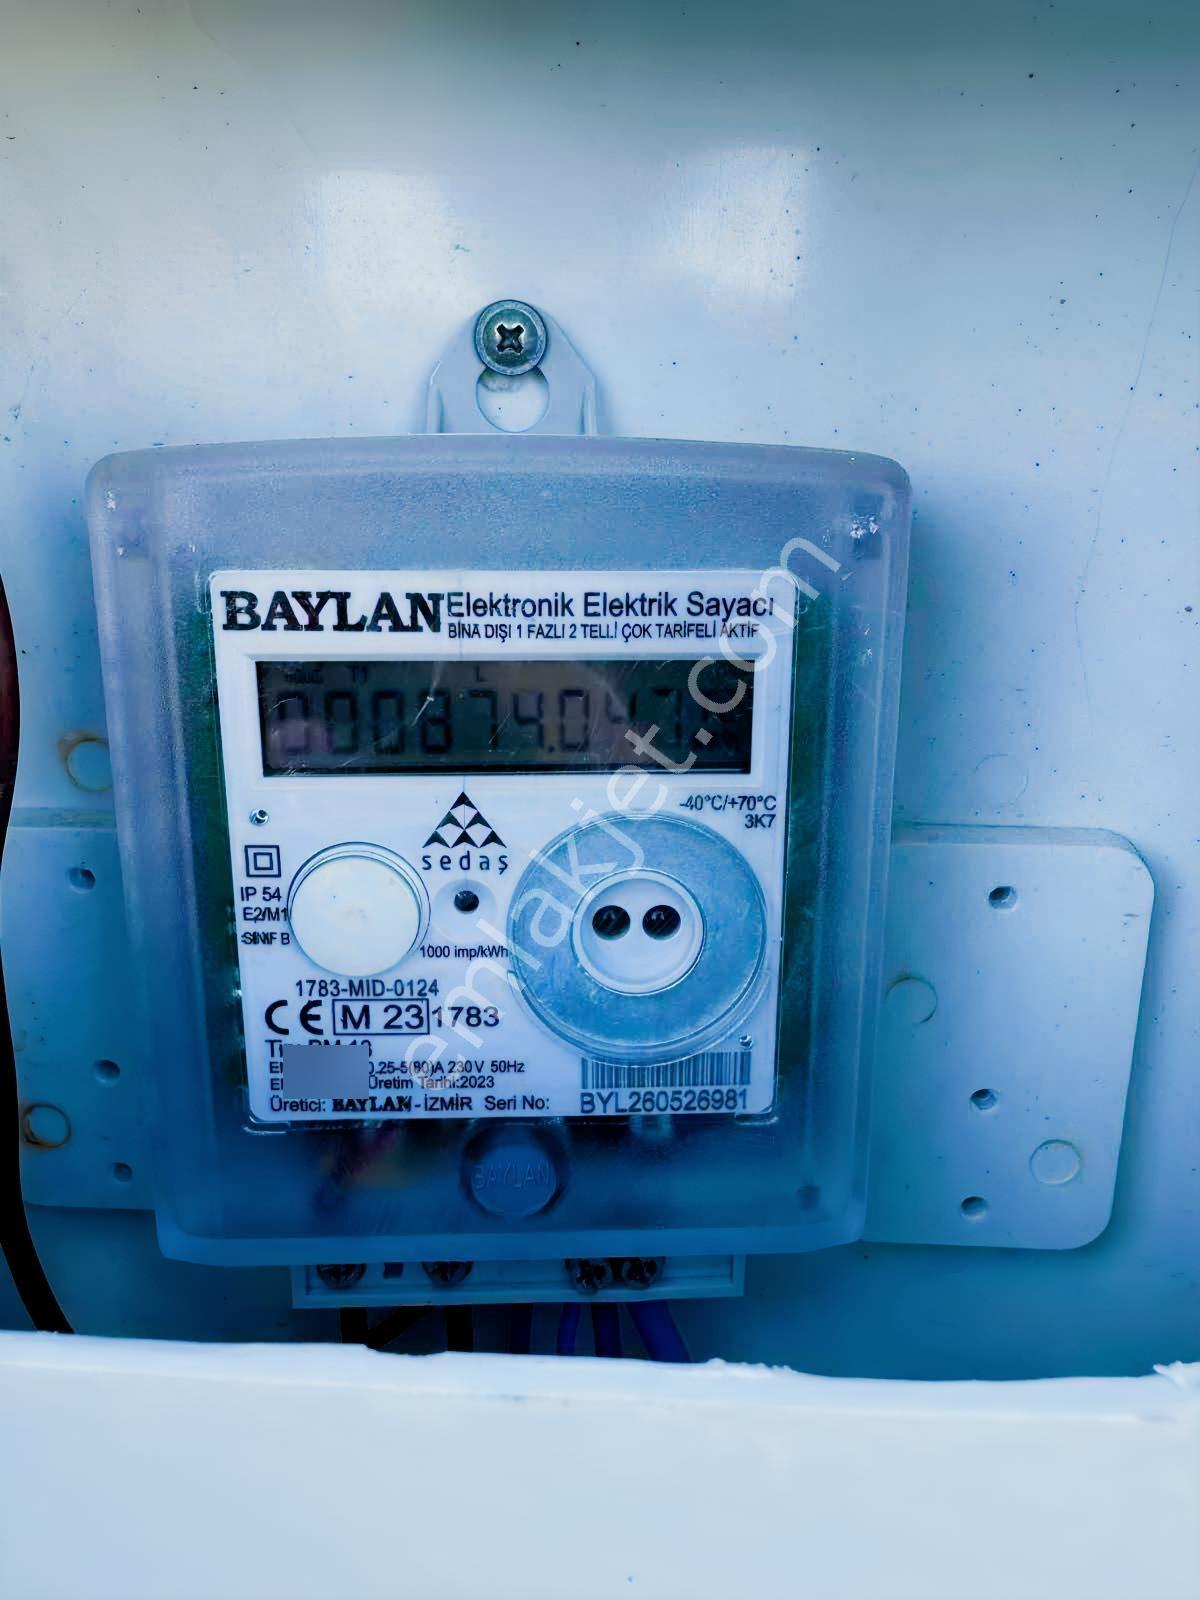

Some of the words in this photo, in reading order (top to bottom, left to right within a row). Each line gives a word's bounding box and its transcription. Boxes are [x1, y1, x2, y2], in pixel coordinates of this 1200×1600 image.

[220, 590, 444, 632] BAYLAN
[447, 591, 574, 618] Elektronik
[583, 591, 678, 618] Elektrik
[686, 590, 774, 622] Sayacı
[448, 620, 481, 639] BİNA
[484, 623, 511, 642] DIŞI
[517, 623, 522, 638] 1
[527, 623, 565, 639] FAZLI
[569, 623, 577, 638] 2
[622, 622, 652, 642] ÇOK
[656, 620, 716, 639] TARİFELİ
[720, 620, 760, 638] AKTİF
[745, 814, 776, 829] 3K7
[422, 850, 508, 875] sedaş
[241, 887, 257, 902] IP
[262, 887, 282, 902] 54
[243, 907, 288, 922] E2/M1
[281, 933, 290, 945] B
[420, 945, 450, 959] 1000
[454, 945, 509, 961] imp/kWh
[295, 979, 439, 998] 1783-MID-0124
[341, 1004, 370, 1030] M
[383, 1004, 425, 1030] 23
[432, 1006, 500, 1028] 1783
[448, 1060, 472, 1074] 230
[490, 1060, 525, 1074] 50Hz
[369, 1074, 414, 1089] Üretim
[271, 1094, 326, 1112] Üretici:
[484, 1094, 517, 1111] Seri
[522, 1094, 550, 1110] No:
[580, 1088, 748, 1114] BYL260526981
